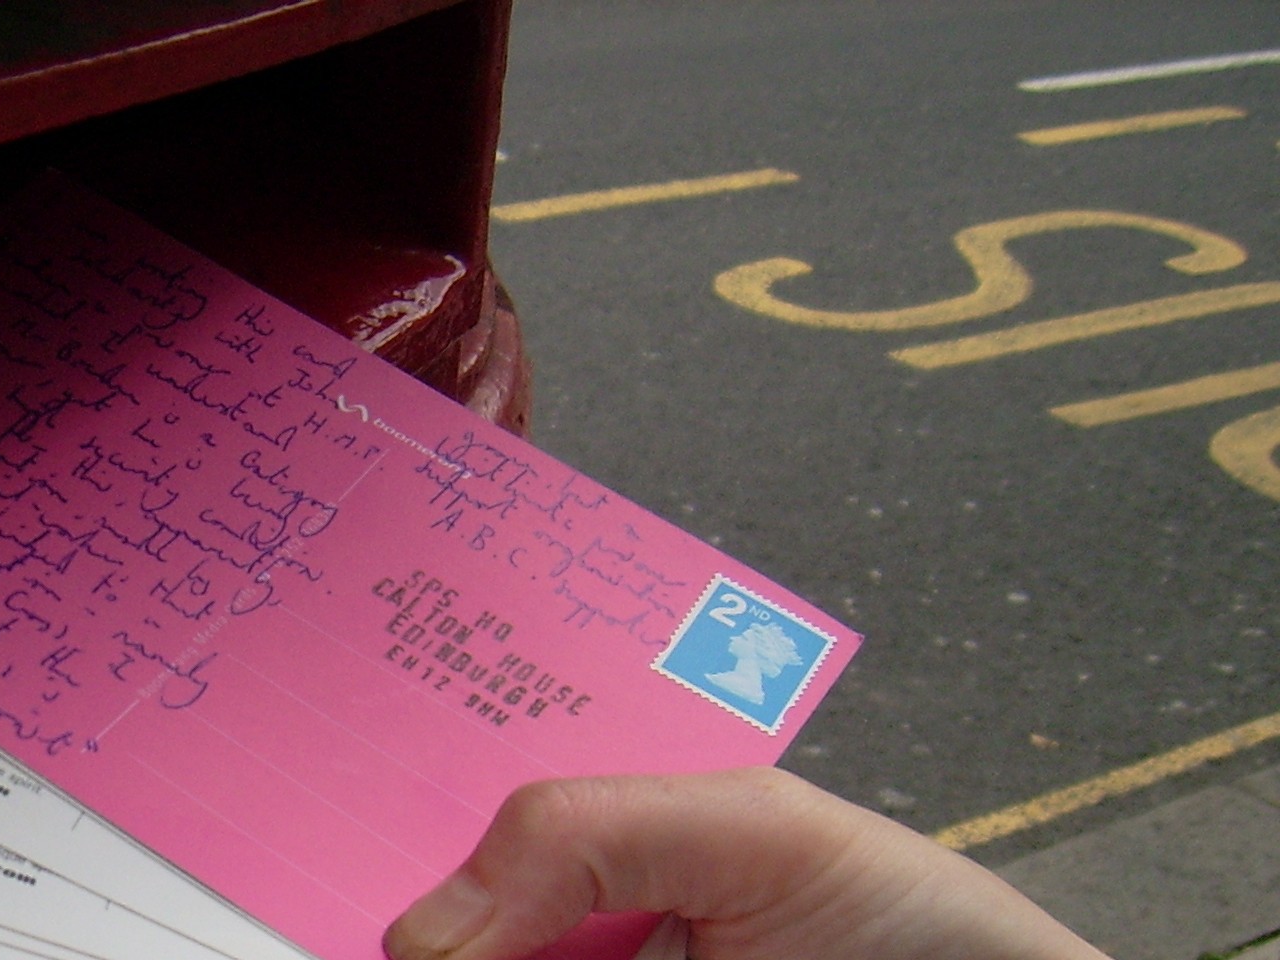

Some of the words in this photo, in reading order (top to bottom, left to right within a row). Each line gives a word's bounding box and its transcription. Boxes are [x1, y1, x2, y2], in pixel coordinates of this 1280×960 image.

[404, 570, 460, 609] SPS
[372, 578, 475, 646] CALTON
[497, 645, 592, 718] HOUSE
[386, 614, 549, 720] EDINBURGH
